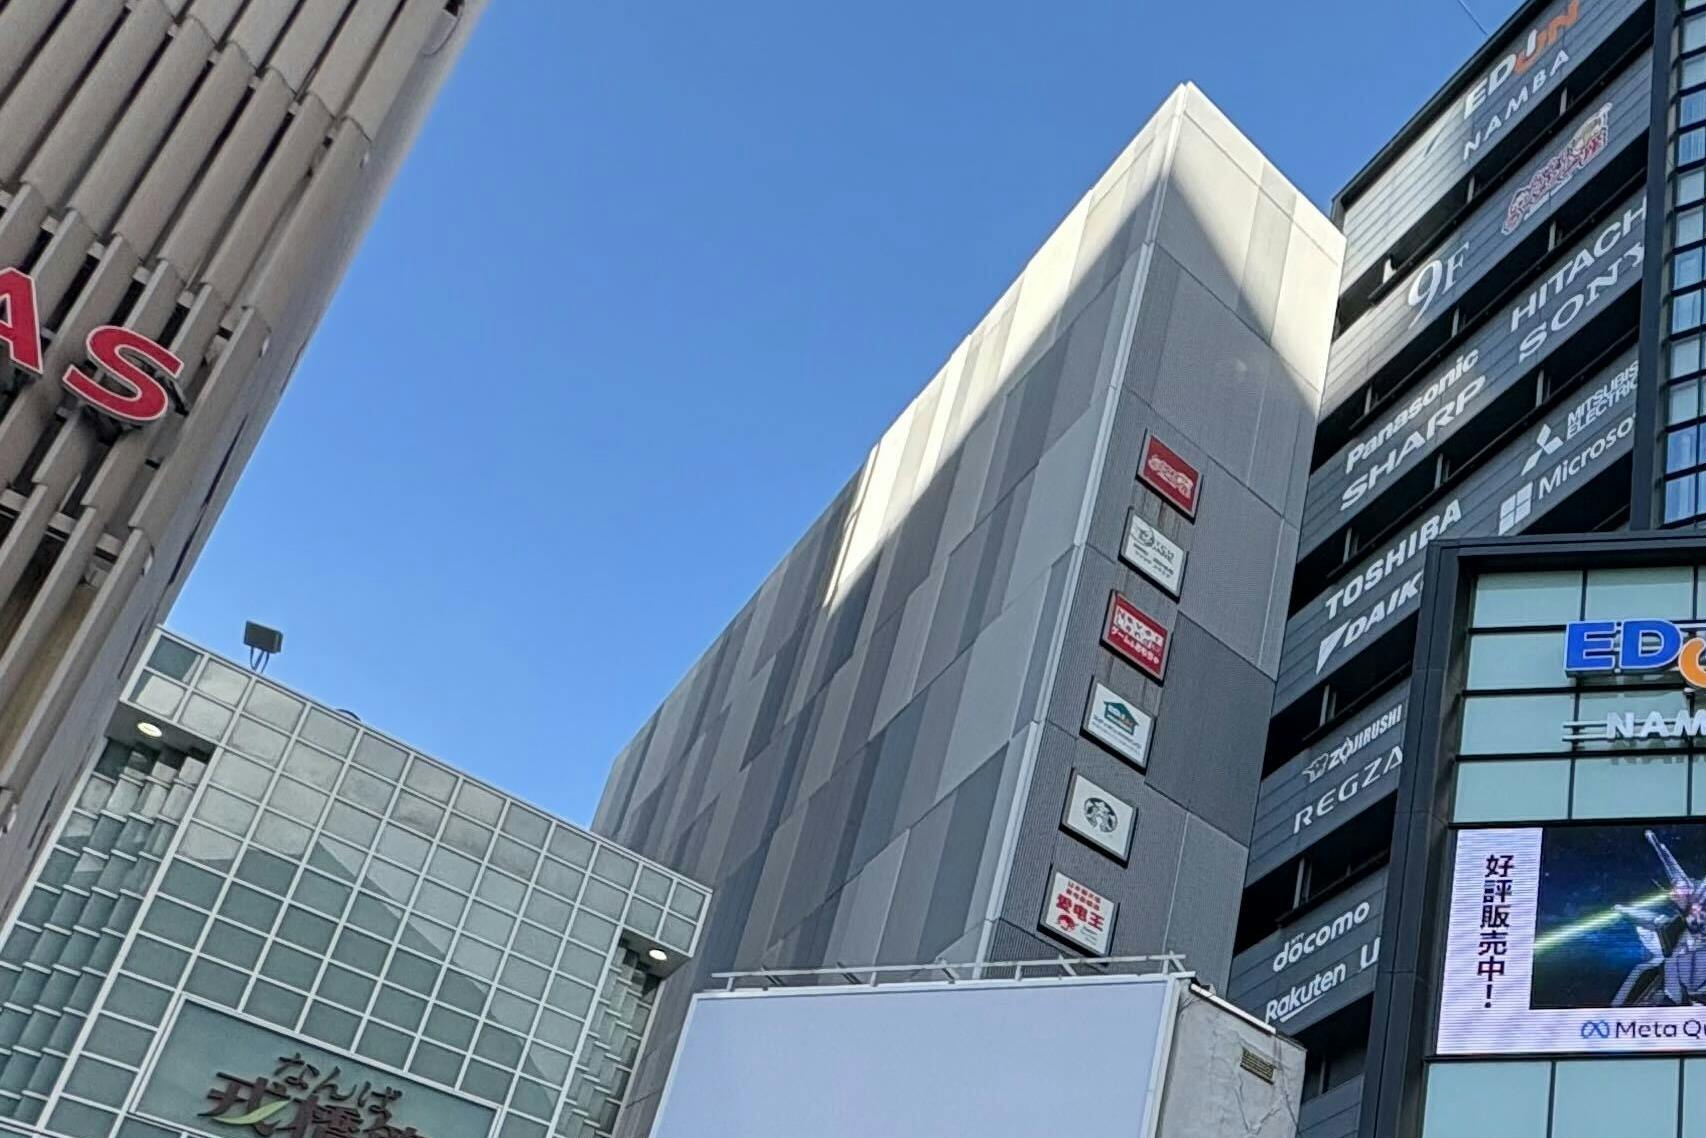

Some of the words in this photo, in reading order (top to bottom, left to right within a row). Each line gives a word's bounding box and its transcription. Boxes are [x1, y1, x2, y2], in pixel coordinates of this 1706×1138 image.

[1464, 50, 1569, 160] NAMBA
[1408, 242, 1471, 331] 9F
[1341, 376, 1486, 511] SHARP
[1345, 350, 1479, 475] Panasonic
[1539, 412, 1637, 500] Microso
[1325, 499, 1462, 620] TOSHIBA
[1331, 704, 1403, 768] ZOJIRUSHI
[1293, 746, 1404, 835] REGZA
[1273, 902, 1370, 974] docomo
[1266, 960, 1346, 1023] Rakuten
[1615, 1020, 1677, 1038] Meta
[276, 1051, 402, 1116] なんば
